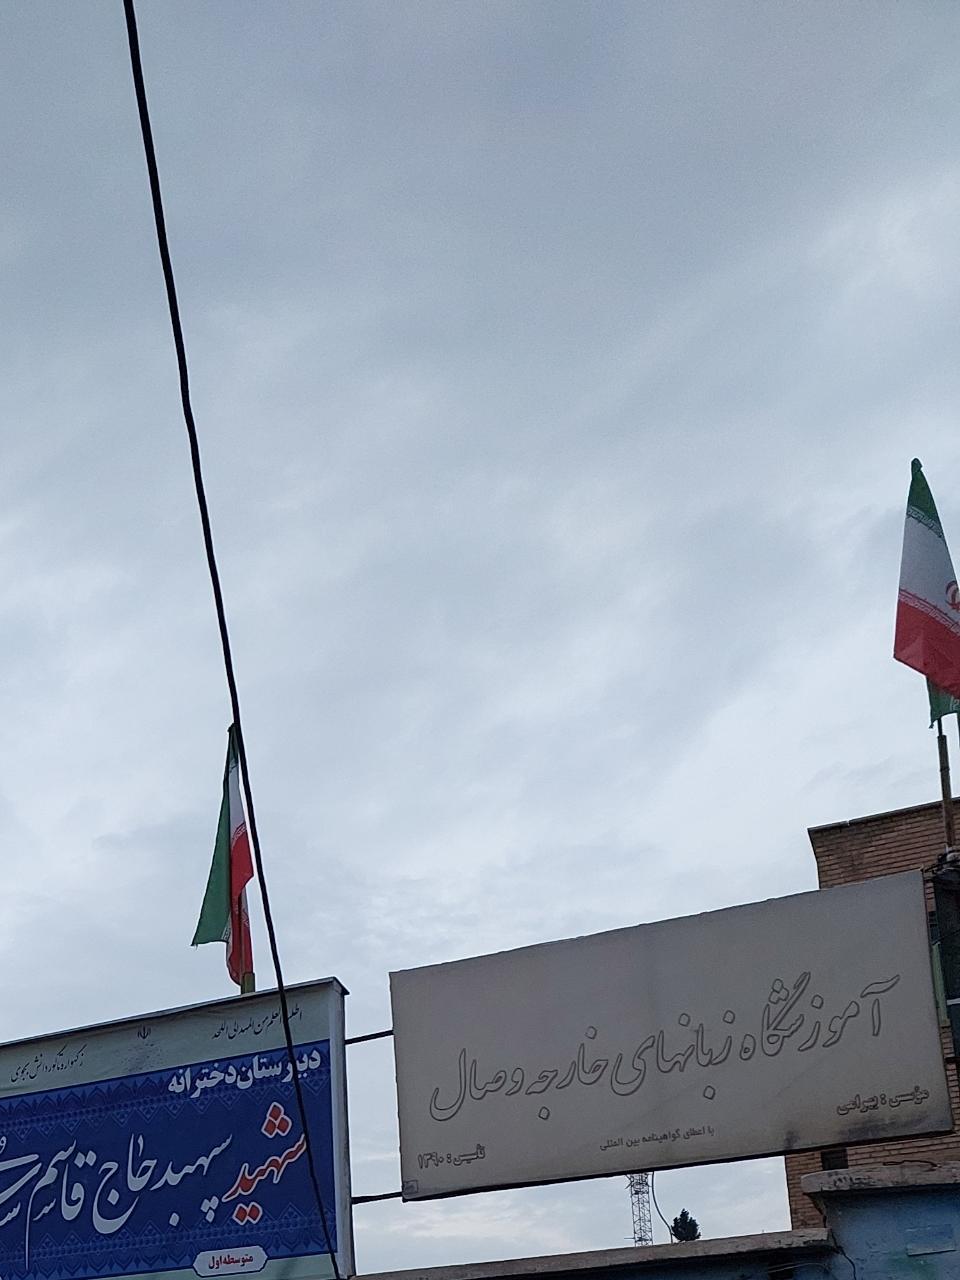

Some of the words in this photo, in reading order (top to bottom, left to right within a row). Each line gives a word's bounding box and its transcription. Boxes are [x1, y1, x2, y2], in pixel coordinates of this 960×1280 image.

[610, 1010, 736, 1100] زبانهای
[739, 972, 901, 1061] آموزشگاه
[168, 1062, 237, 1098] دخترانه
[236, 1050, 321, 1089] دبیرستان
[429, 1048, 525, 1121] وصال
[525, 1026, 609, 1120] خارجه
[25, 1139, 97, 1270] قاسم
[92, 1132, 158, 1234] حاج
[149, 1133, 233, 1226] سپهبد
[221, 1102, 307, 1226] شهید
[208, 1255, 222, 1270] اول
[223, 1253, 254, 1267] متوسطه
